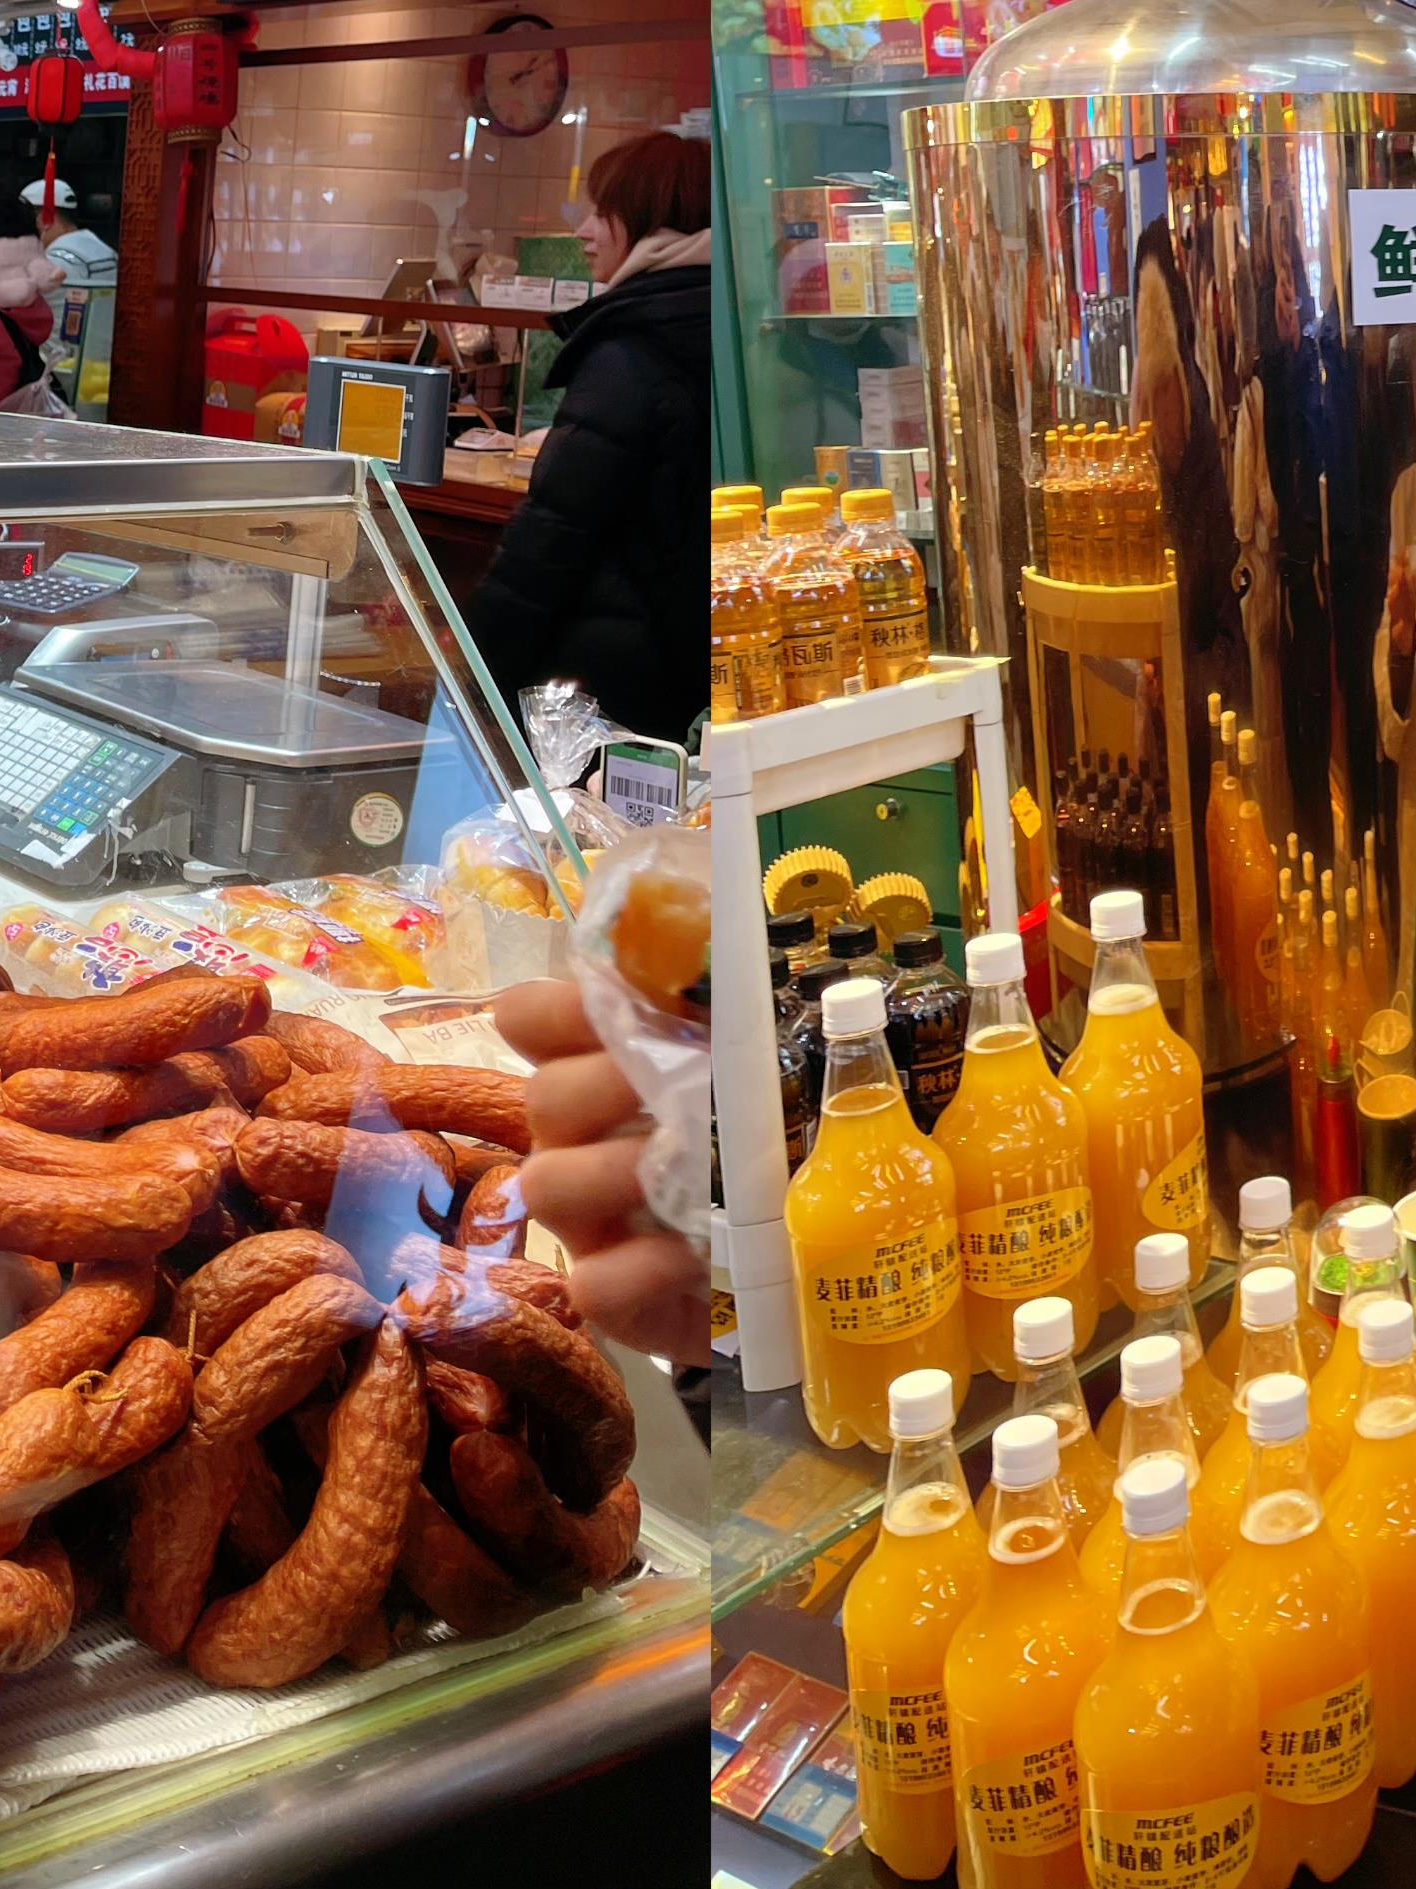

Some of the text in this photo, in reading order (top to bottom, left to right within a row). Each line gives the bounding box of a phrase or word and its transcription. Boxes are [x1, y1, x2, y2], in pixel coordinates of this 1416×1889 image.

[127, 914, 173, 940] 豆沙包
[814, 1268, 903, 1302] 麦菲精酿
[970, 1776, 1059, 1813] 麦菲精酿
[1136, 1811, 1196, 1830] MCFEE
[1174, 1804, 1255, 1868] 纯粮酿造
